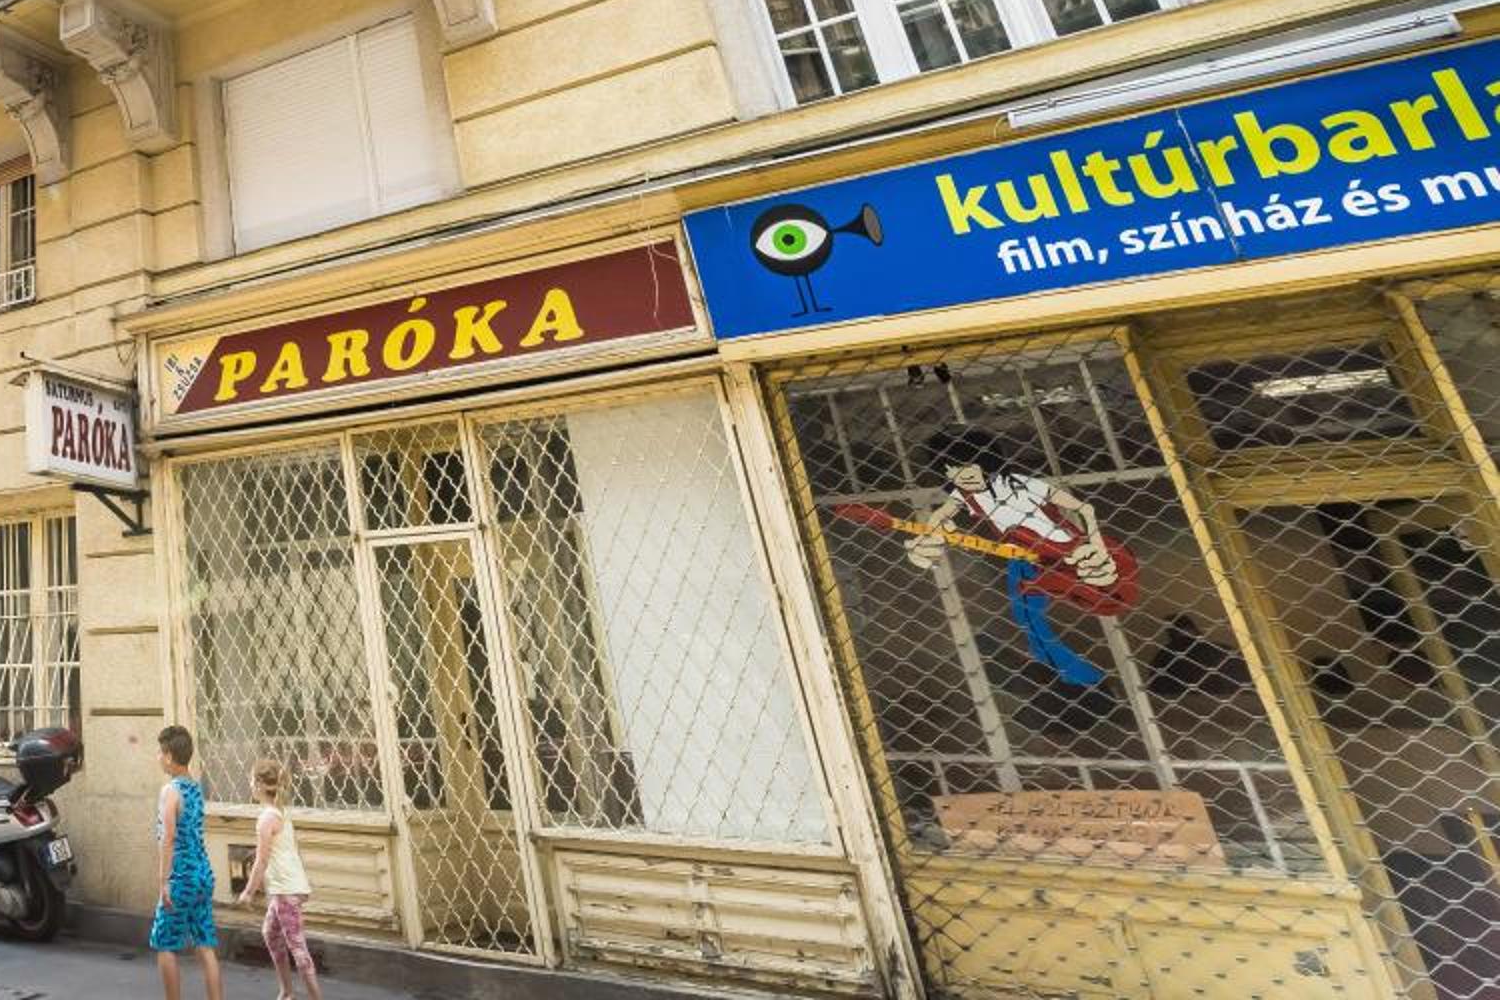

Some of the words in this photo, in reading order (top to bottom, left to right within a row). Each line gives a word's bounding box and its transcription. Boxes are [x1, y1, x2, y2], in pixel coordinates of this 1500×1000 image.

[936, 67, 1500, 235] kultúrbarl
[998, 238, 1109, 275] film,
[1119, 196, 1332, 256] színház
[1342, 179, 1411, 218] és
[214, 287, 585, 402] PARÓKA
[51, 402, 132, 473] PARÓKA
